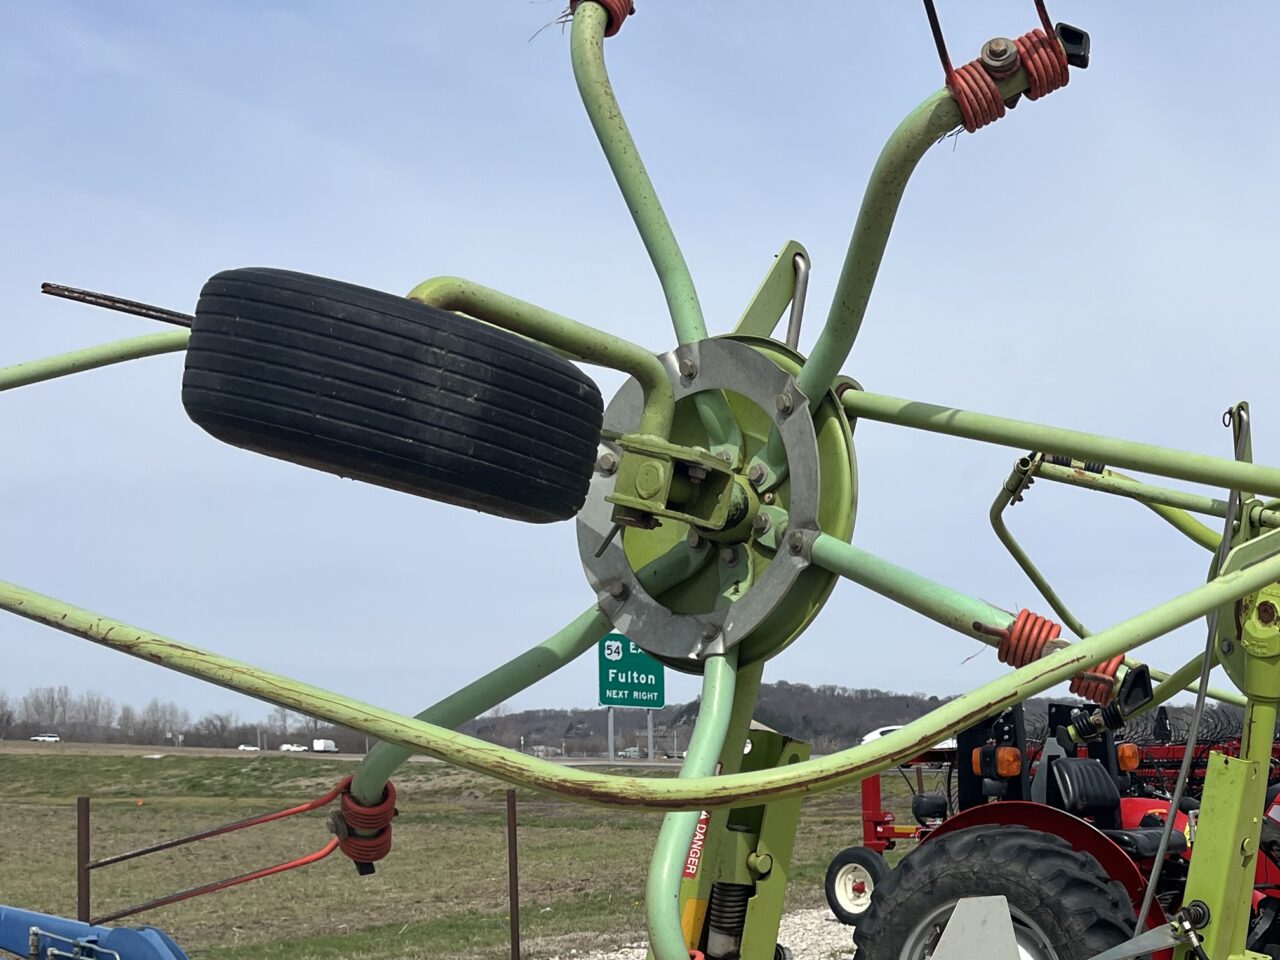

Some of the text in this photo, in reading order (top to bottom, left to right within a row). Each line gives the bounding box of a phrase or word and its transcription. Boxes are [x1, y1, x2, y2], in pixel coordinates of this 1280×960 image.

[606, 645, 620, 655] 54
[609, 670, 655, 684] Fulton
[606, 690, 657, 700] NEXT RIGHT
[685, 824, 707, 874] DANGER
